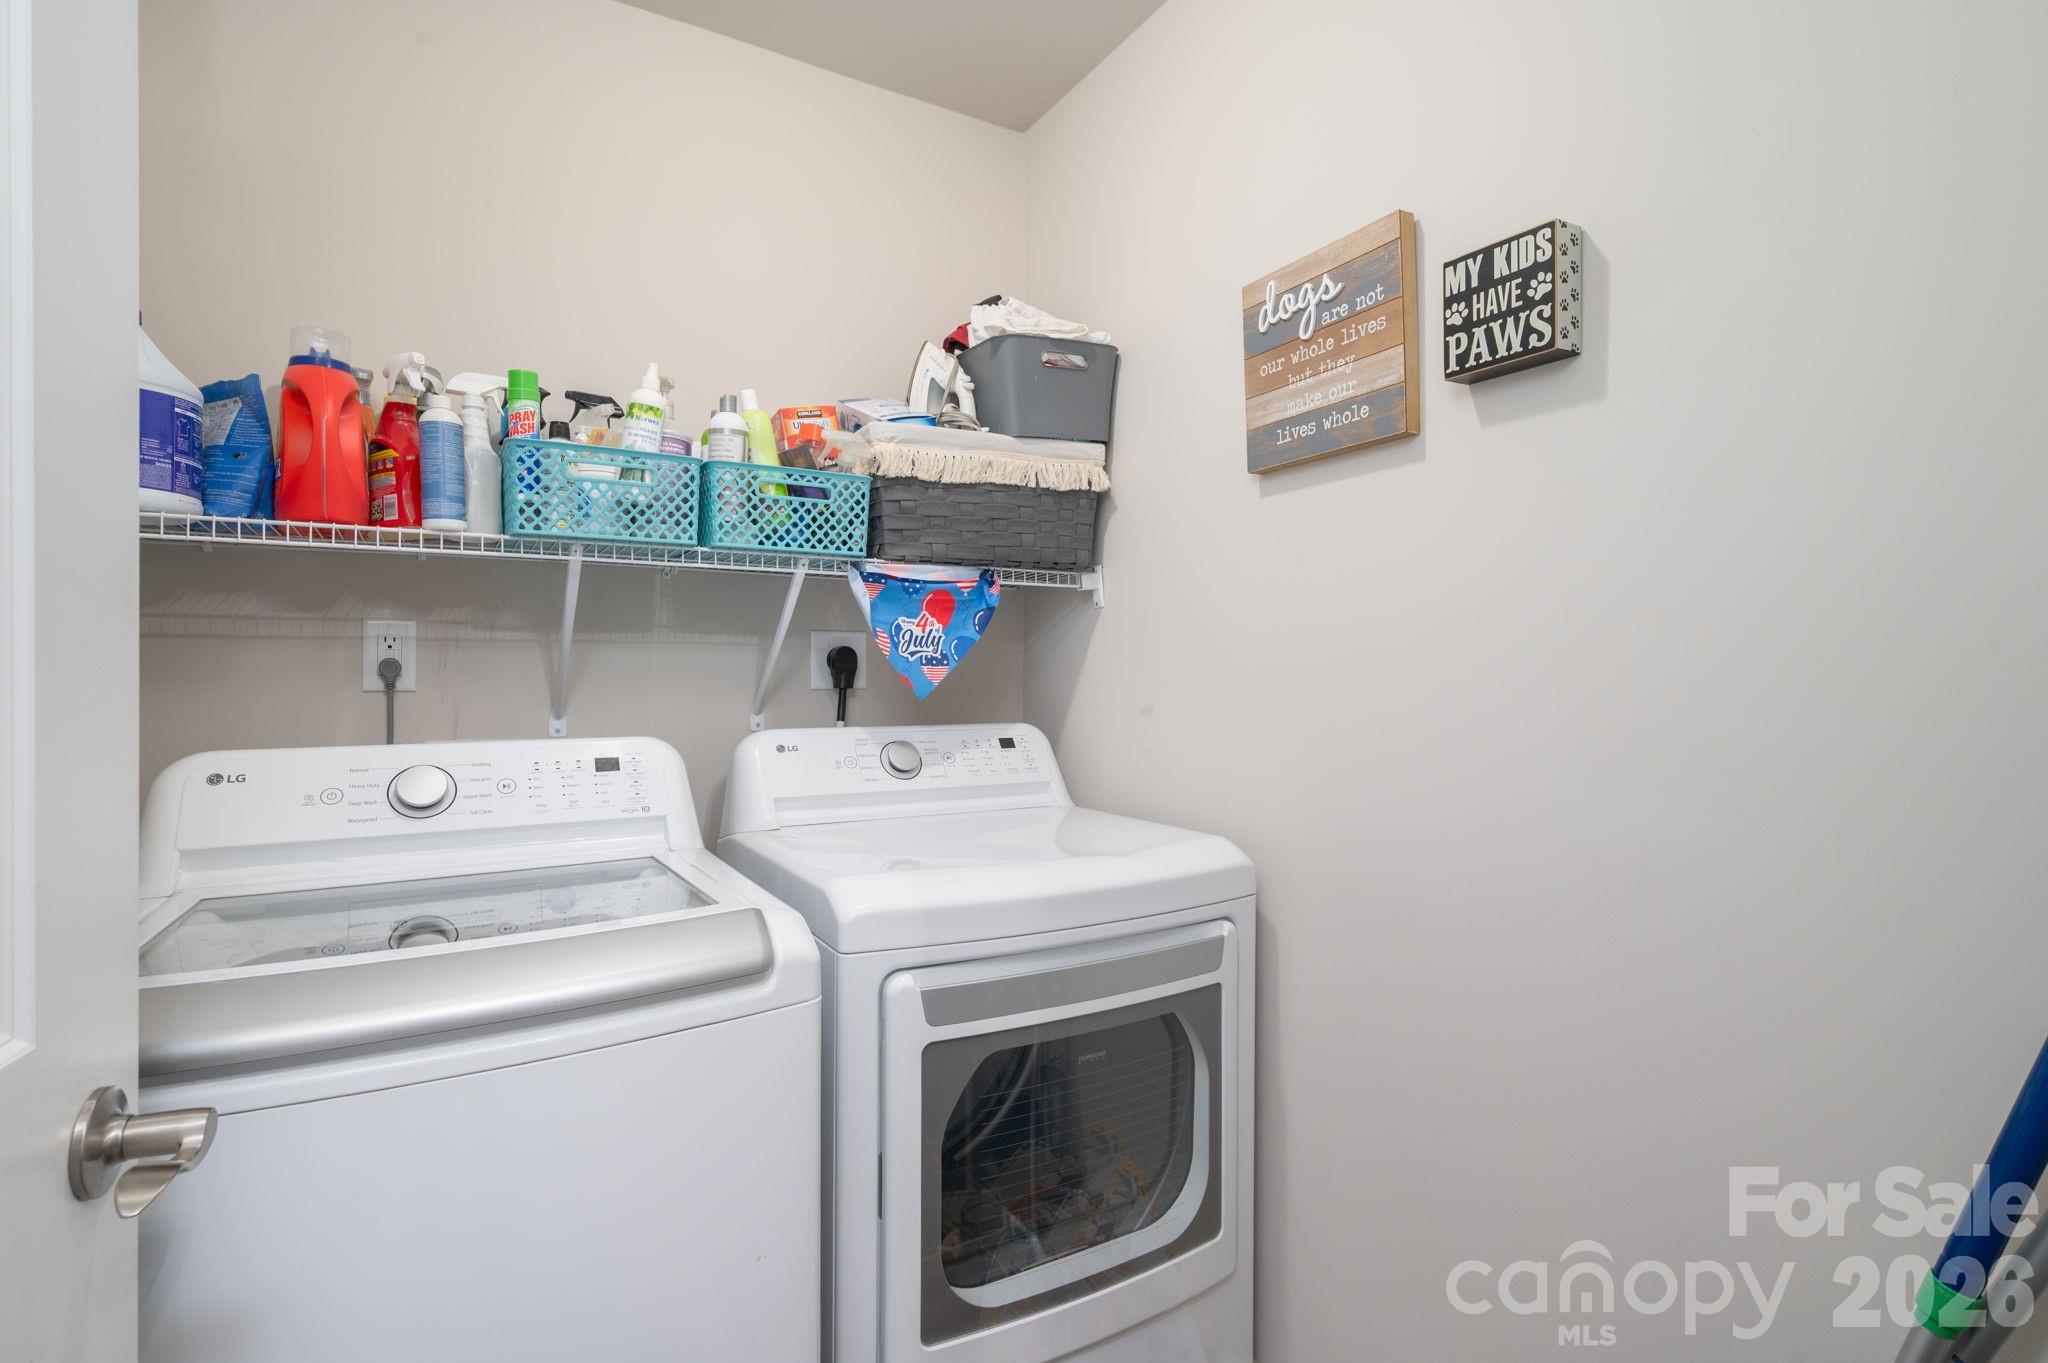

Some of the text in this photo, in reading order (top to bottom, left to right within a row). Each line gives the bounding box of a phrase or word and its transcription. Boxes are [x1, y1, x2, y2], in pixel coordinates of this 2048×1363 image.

[1444, 226, 1553, 298] MY KIDS
[1257, 273, 1345, 340] dogs
[1321, 283, 1386, 326] are not
[1472, 278, 1523, 322] HAVE
[1260, 315, 1387, 378] our whole lives
[1445, 302, 1554, 374] PAWS
[1288, 353, 1356, 390] but they
[509, 410, 537, 426] PRAY
[1286, 379, 1357, 415] make our
[1276, 403, 1370, 446] lives whole
[900, 628, 943, 655] July
[226, 773, 247, 784] LG
